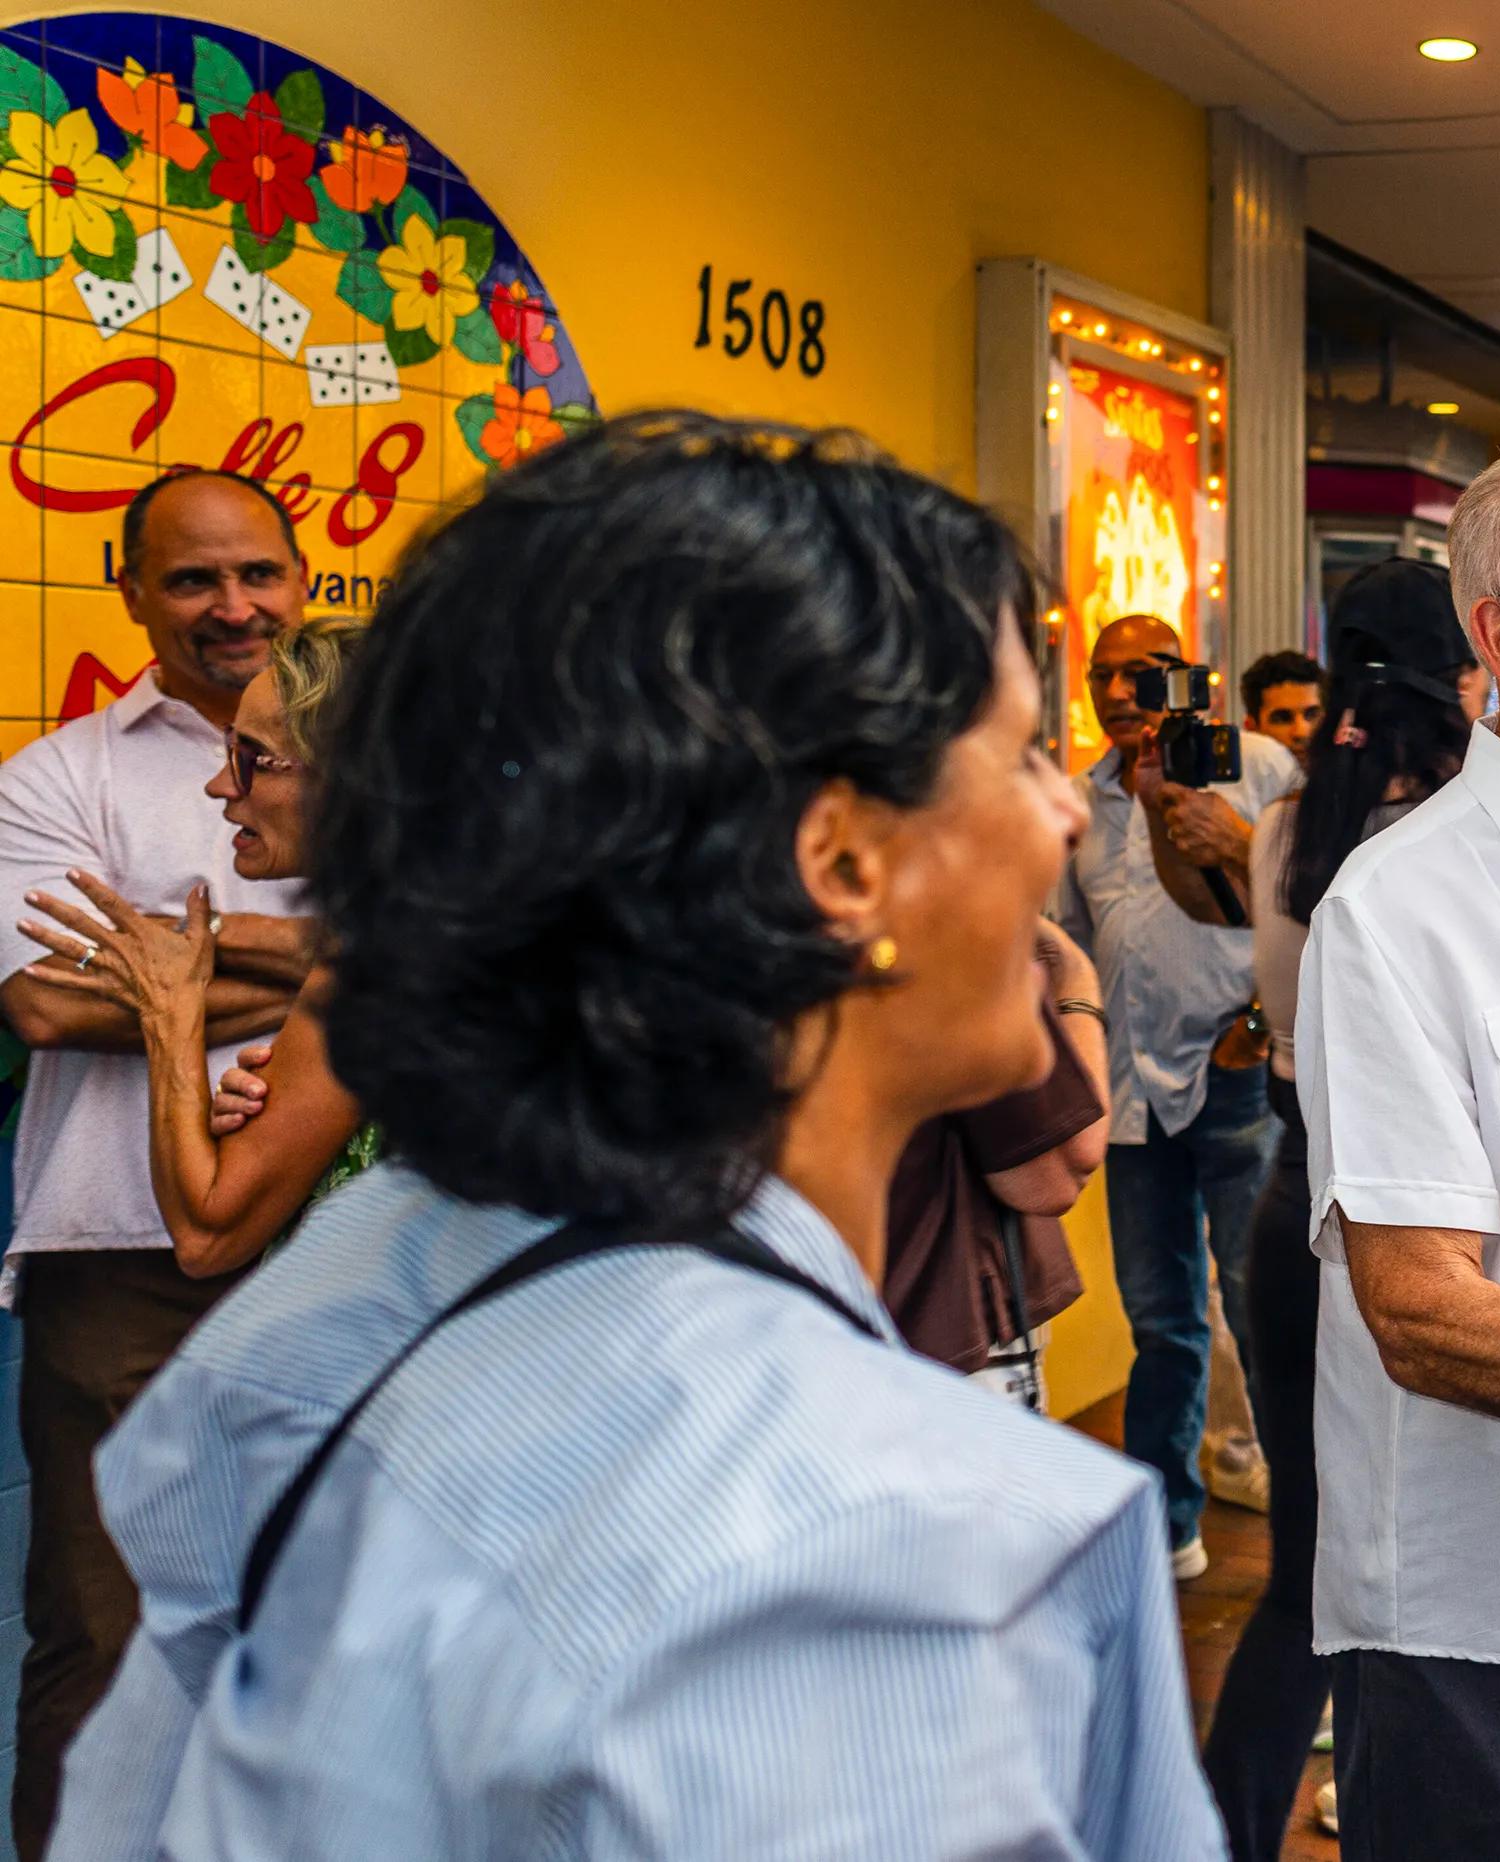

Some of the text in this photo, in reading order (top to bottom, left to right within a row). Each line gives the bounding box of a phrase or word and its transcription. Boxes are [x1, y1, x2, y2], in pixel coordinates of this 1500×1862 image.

[695, 264, 825, 379] 1508
[10, 357, 424, 547] Clle 8
